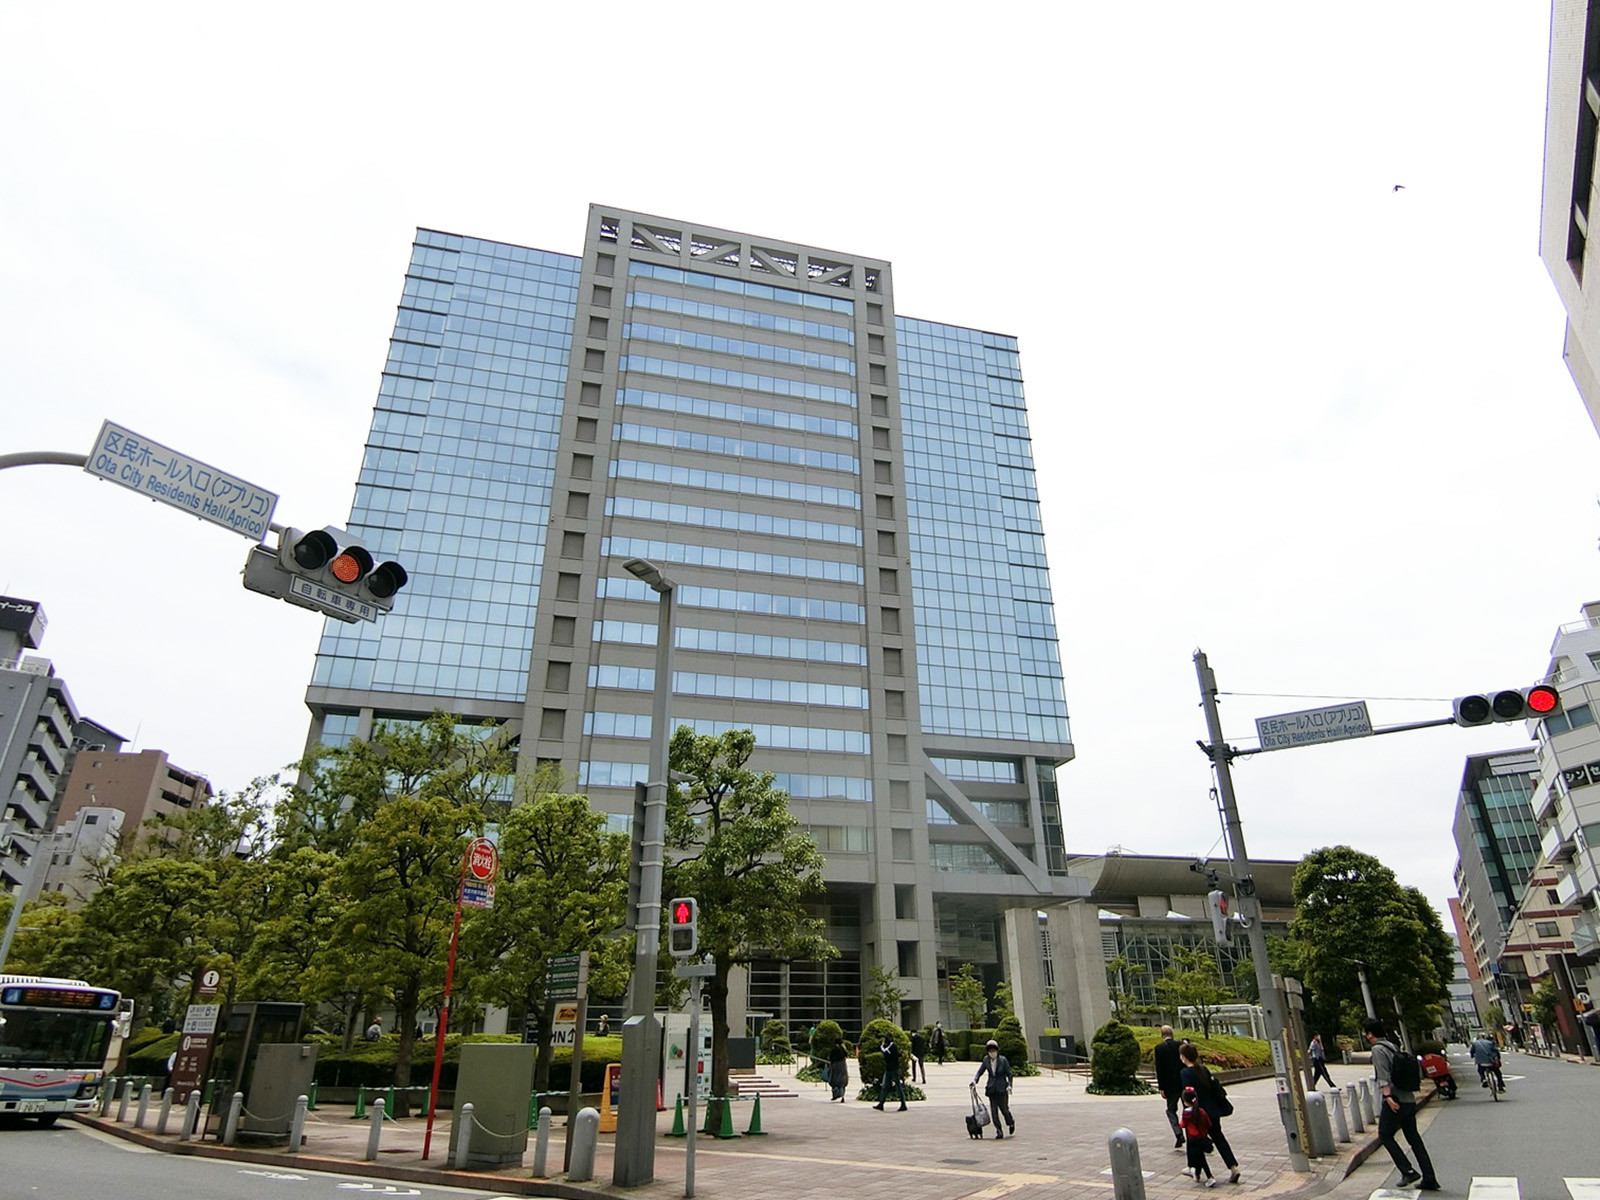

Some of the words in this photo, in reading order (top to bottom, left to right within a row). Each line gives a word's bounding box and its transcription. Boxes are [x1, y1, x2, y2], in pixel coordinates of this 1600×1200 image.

[96, 454, 117, 474] Ota
[121, 464, 144, 487] City
[146, 475, 200, 510] Residents
[104, 431, 269, 517] 区民ホール入口(アプリコ)
[301, 583, 370, 617] 自転車専用
[1261, 706, 1364, 735] 区民ホール入口(アプリコ)
[1278, 735, 1291, 745] City
[1292, 729, 1326, 743] Residents
